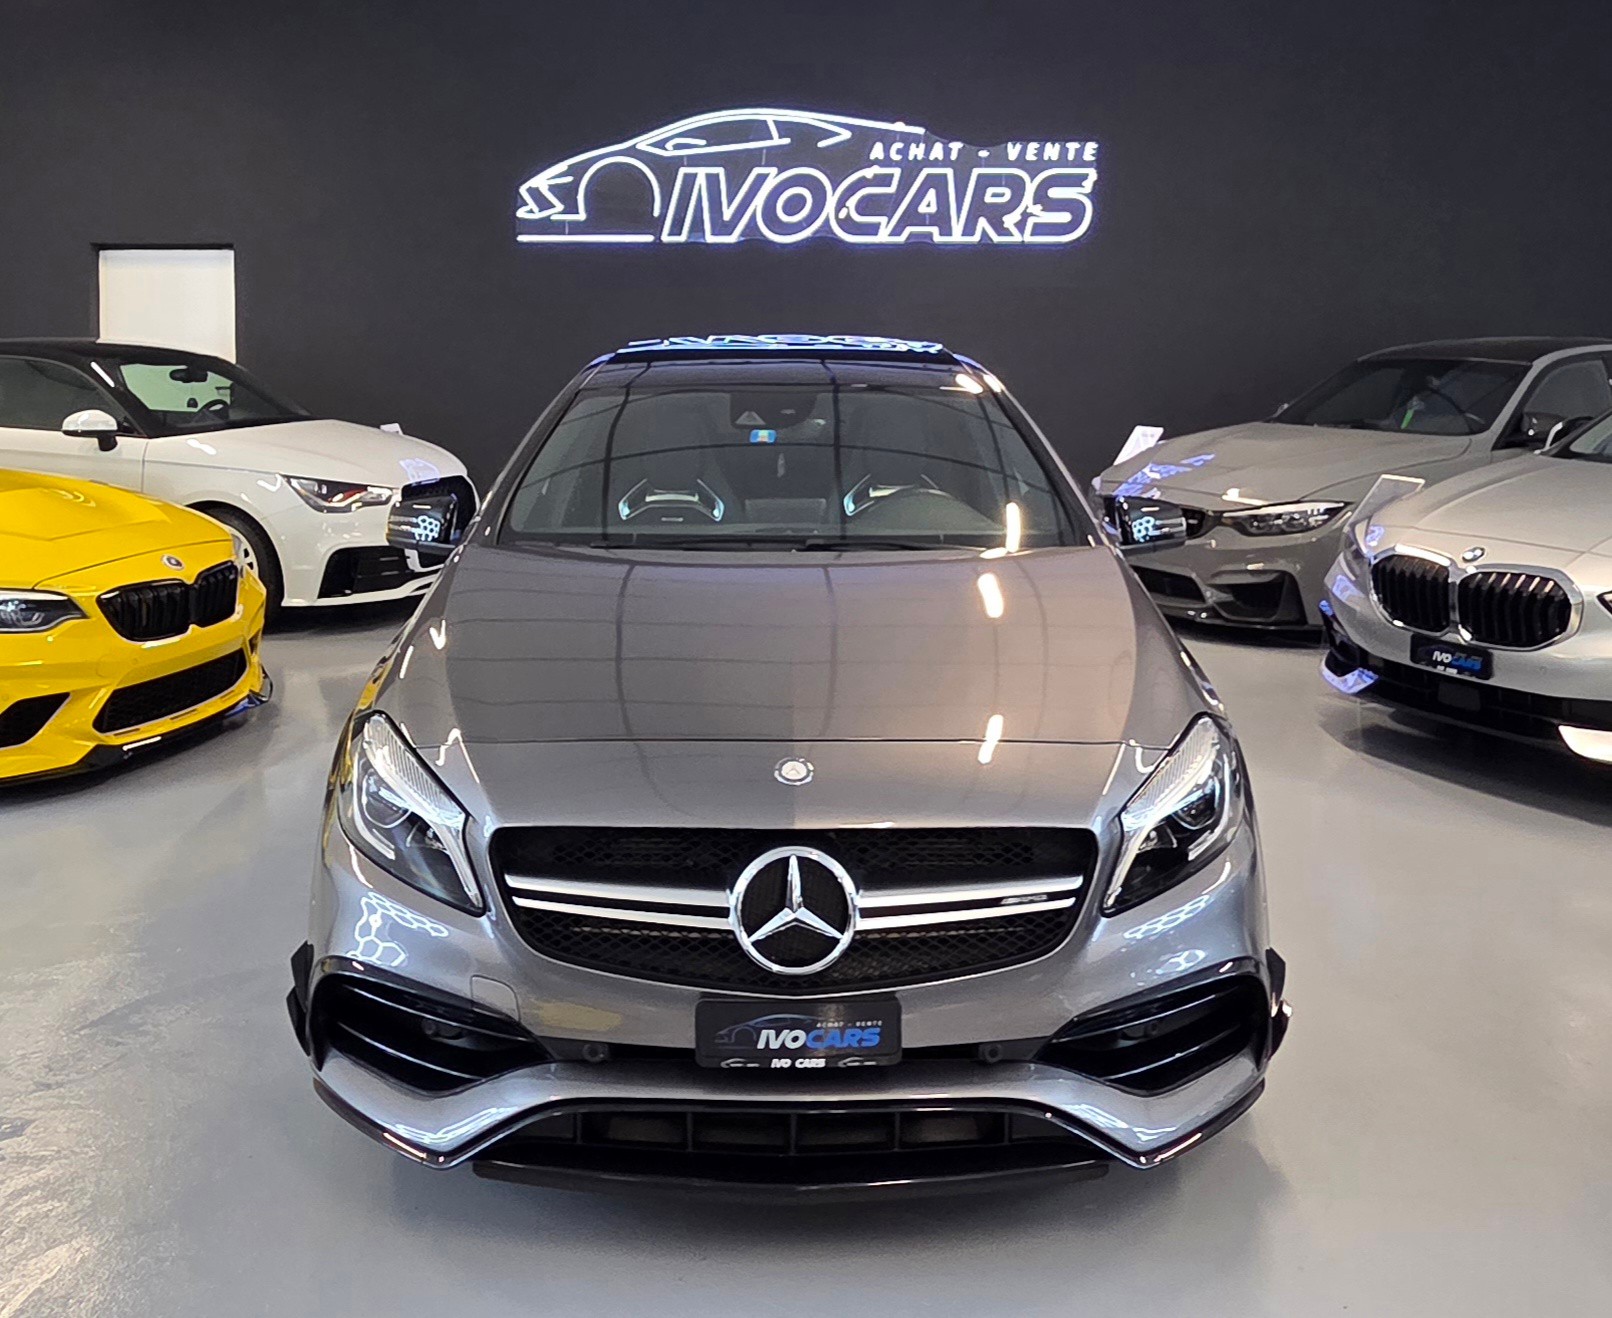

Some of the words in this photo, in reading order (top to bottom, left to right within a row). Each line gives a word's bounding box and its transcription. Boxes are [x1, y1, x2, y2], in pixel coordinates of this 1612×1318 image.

[869, 141, 964, 161] ACHAT
[1006, 141, 1099, 161] VENTE
[660, 165, 1097, 243] IVOCARS
[757, 1028, 881, 1049] IVOCARS
